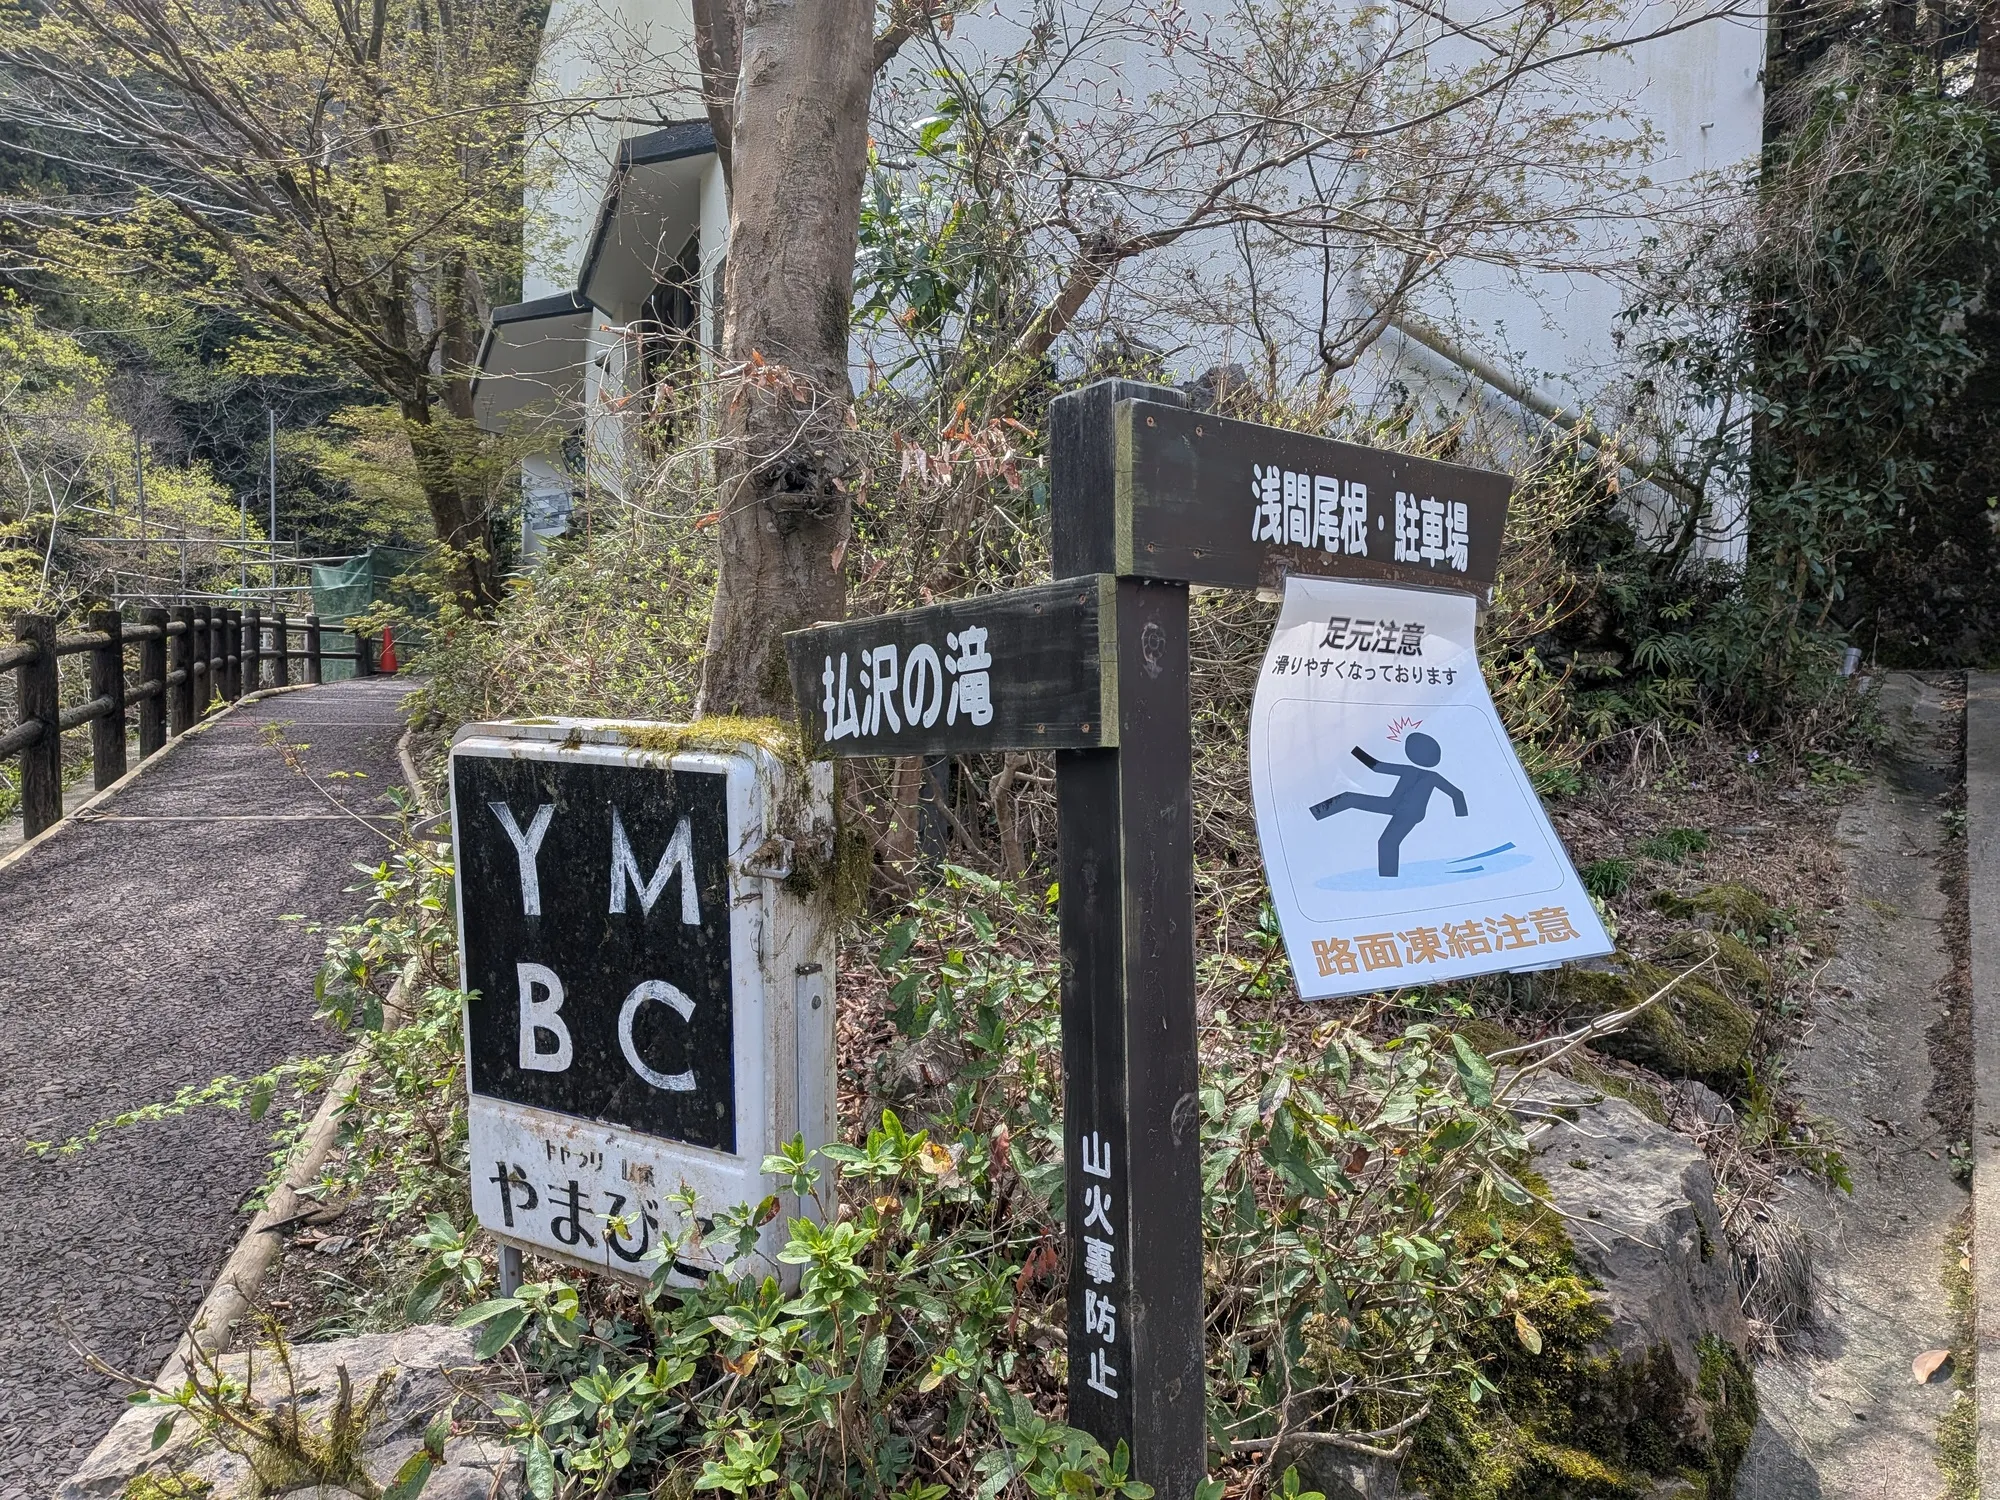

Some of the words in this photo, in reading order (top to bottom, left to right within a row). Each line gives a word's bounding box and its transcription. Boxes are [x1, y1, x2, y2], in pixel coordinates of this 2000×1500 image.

[1252, 463, 1469, 573] 浅間尾根・駐車場
[1272, 655, 1458, 686] 滑りやすくなっております
[1319, 616, 1426, 656] 足元注意
[822, 625, 993, 742] 払沢の滝
[1311, 906, 1581, 977] 路面凍結注意
[1082, 1131, 1118, 1399] 山火事防止
